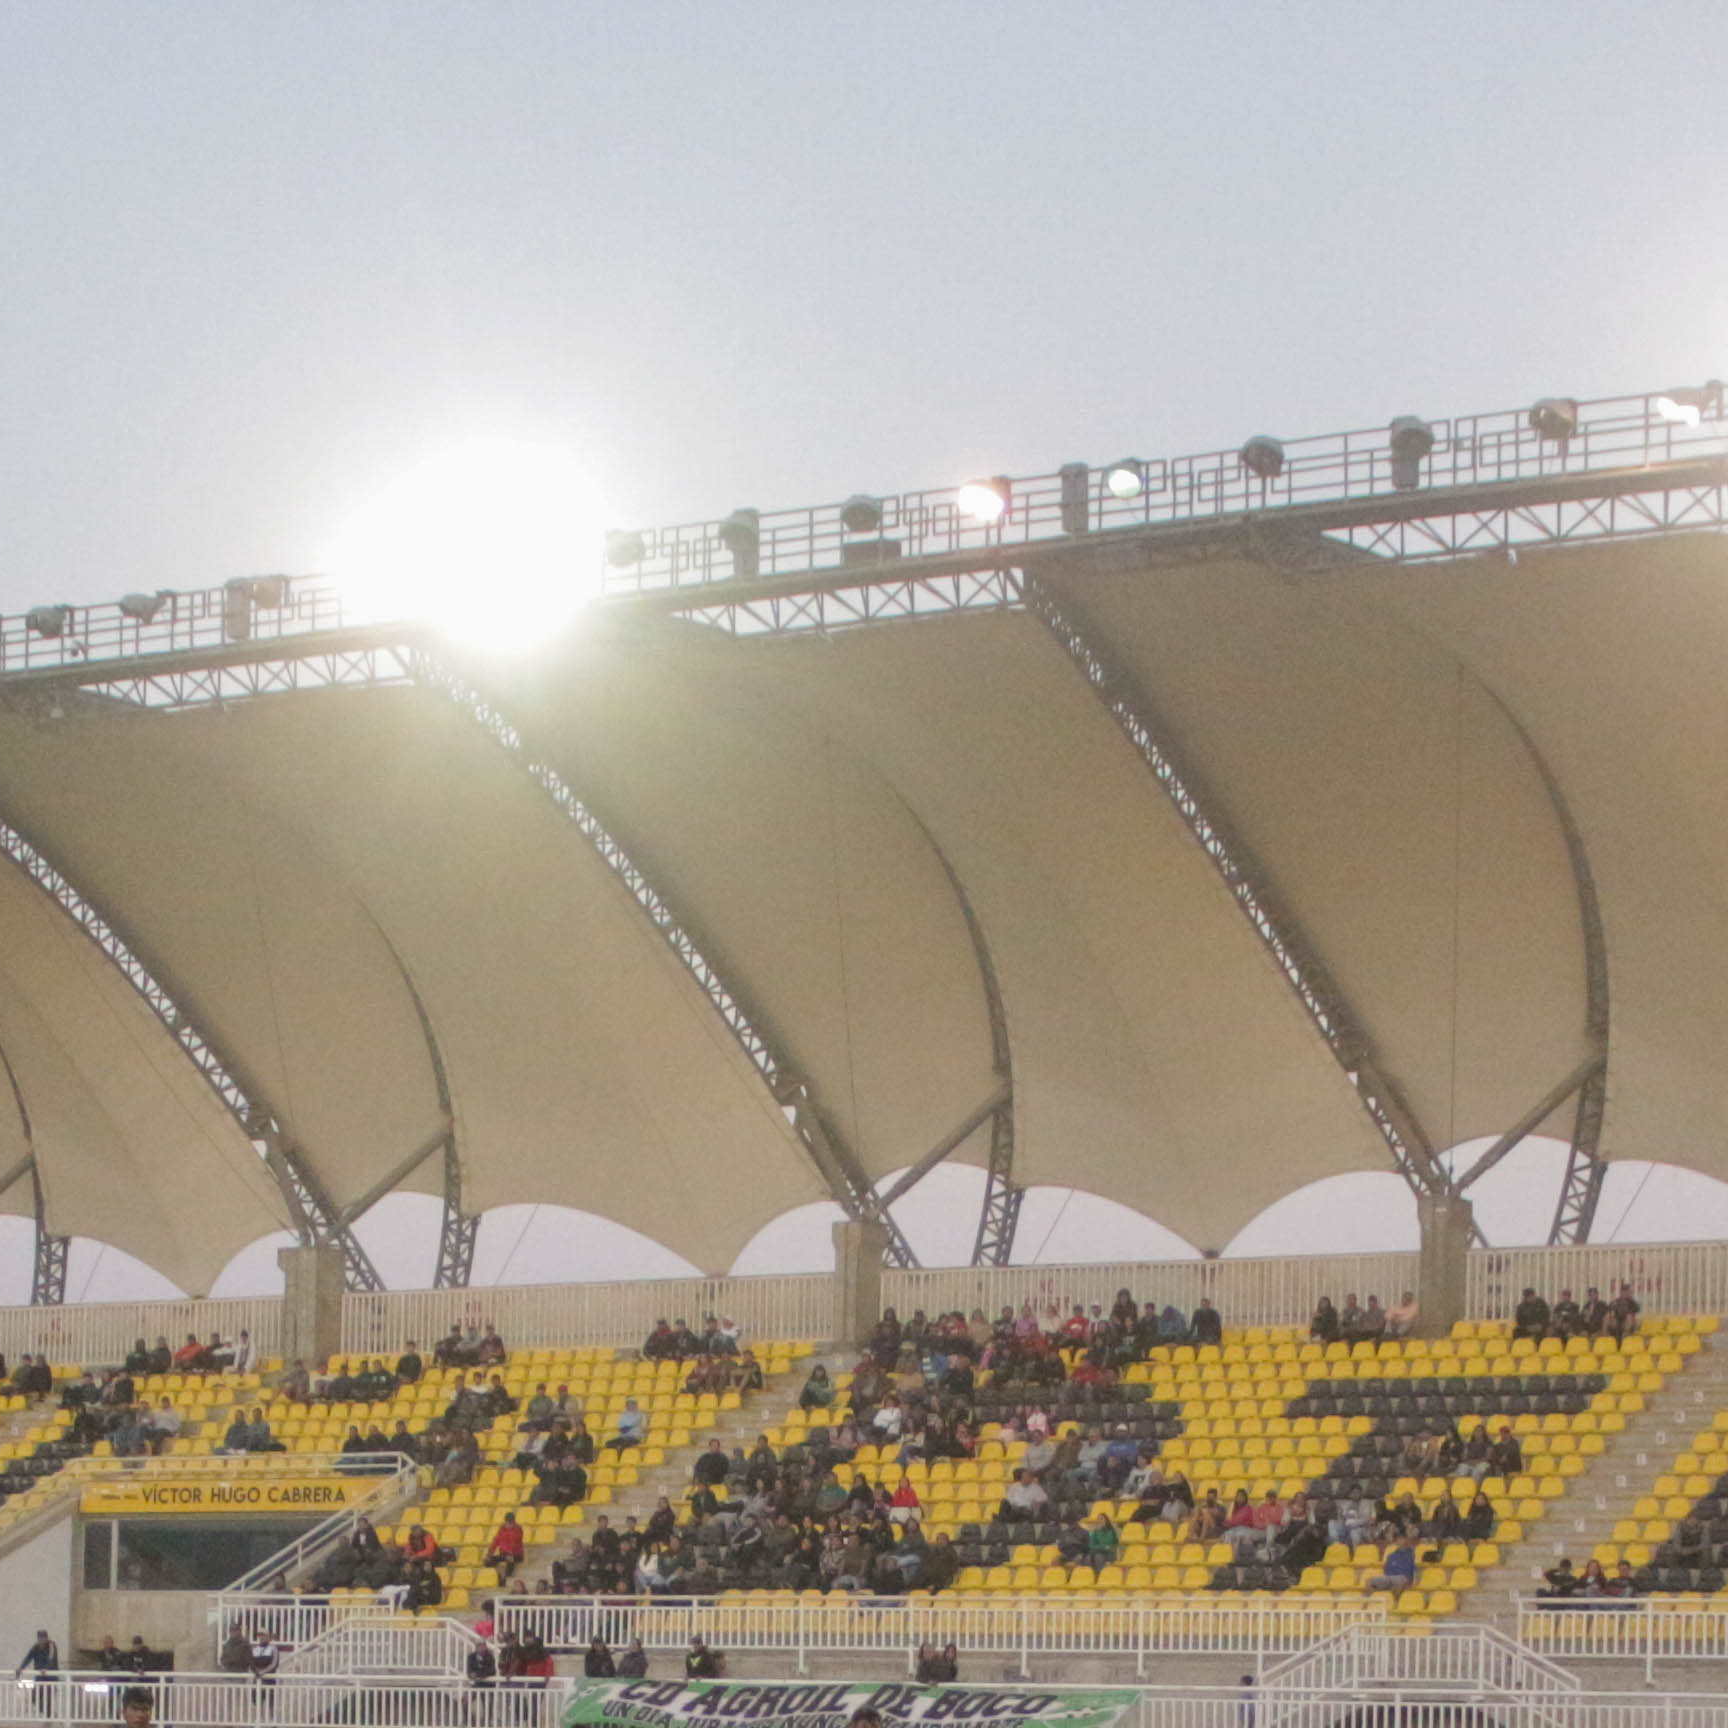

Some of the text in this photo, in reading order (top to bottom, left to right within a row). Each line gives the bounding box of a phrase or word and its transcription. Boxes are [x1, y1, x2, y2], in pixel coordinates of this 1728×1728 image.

[142, 1484, 201, 1504] VÍCTOR
[211, 1487, 260, 1504] HUGO
[268, 1486, 346, 1503] CABRERA
